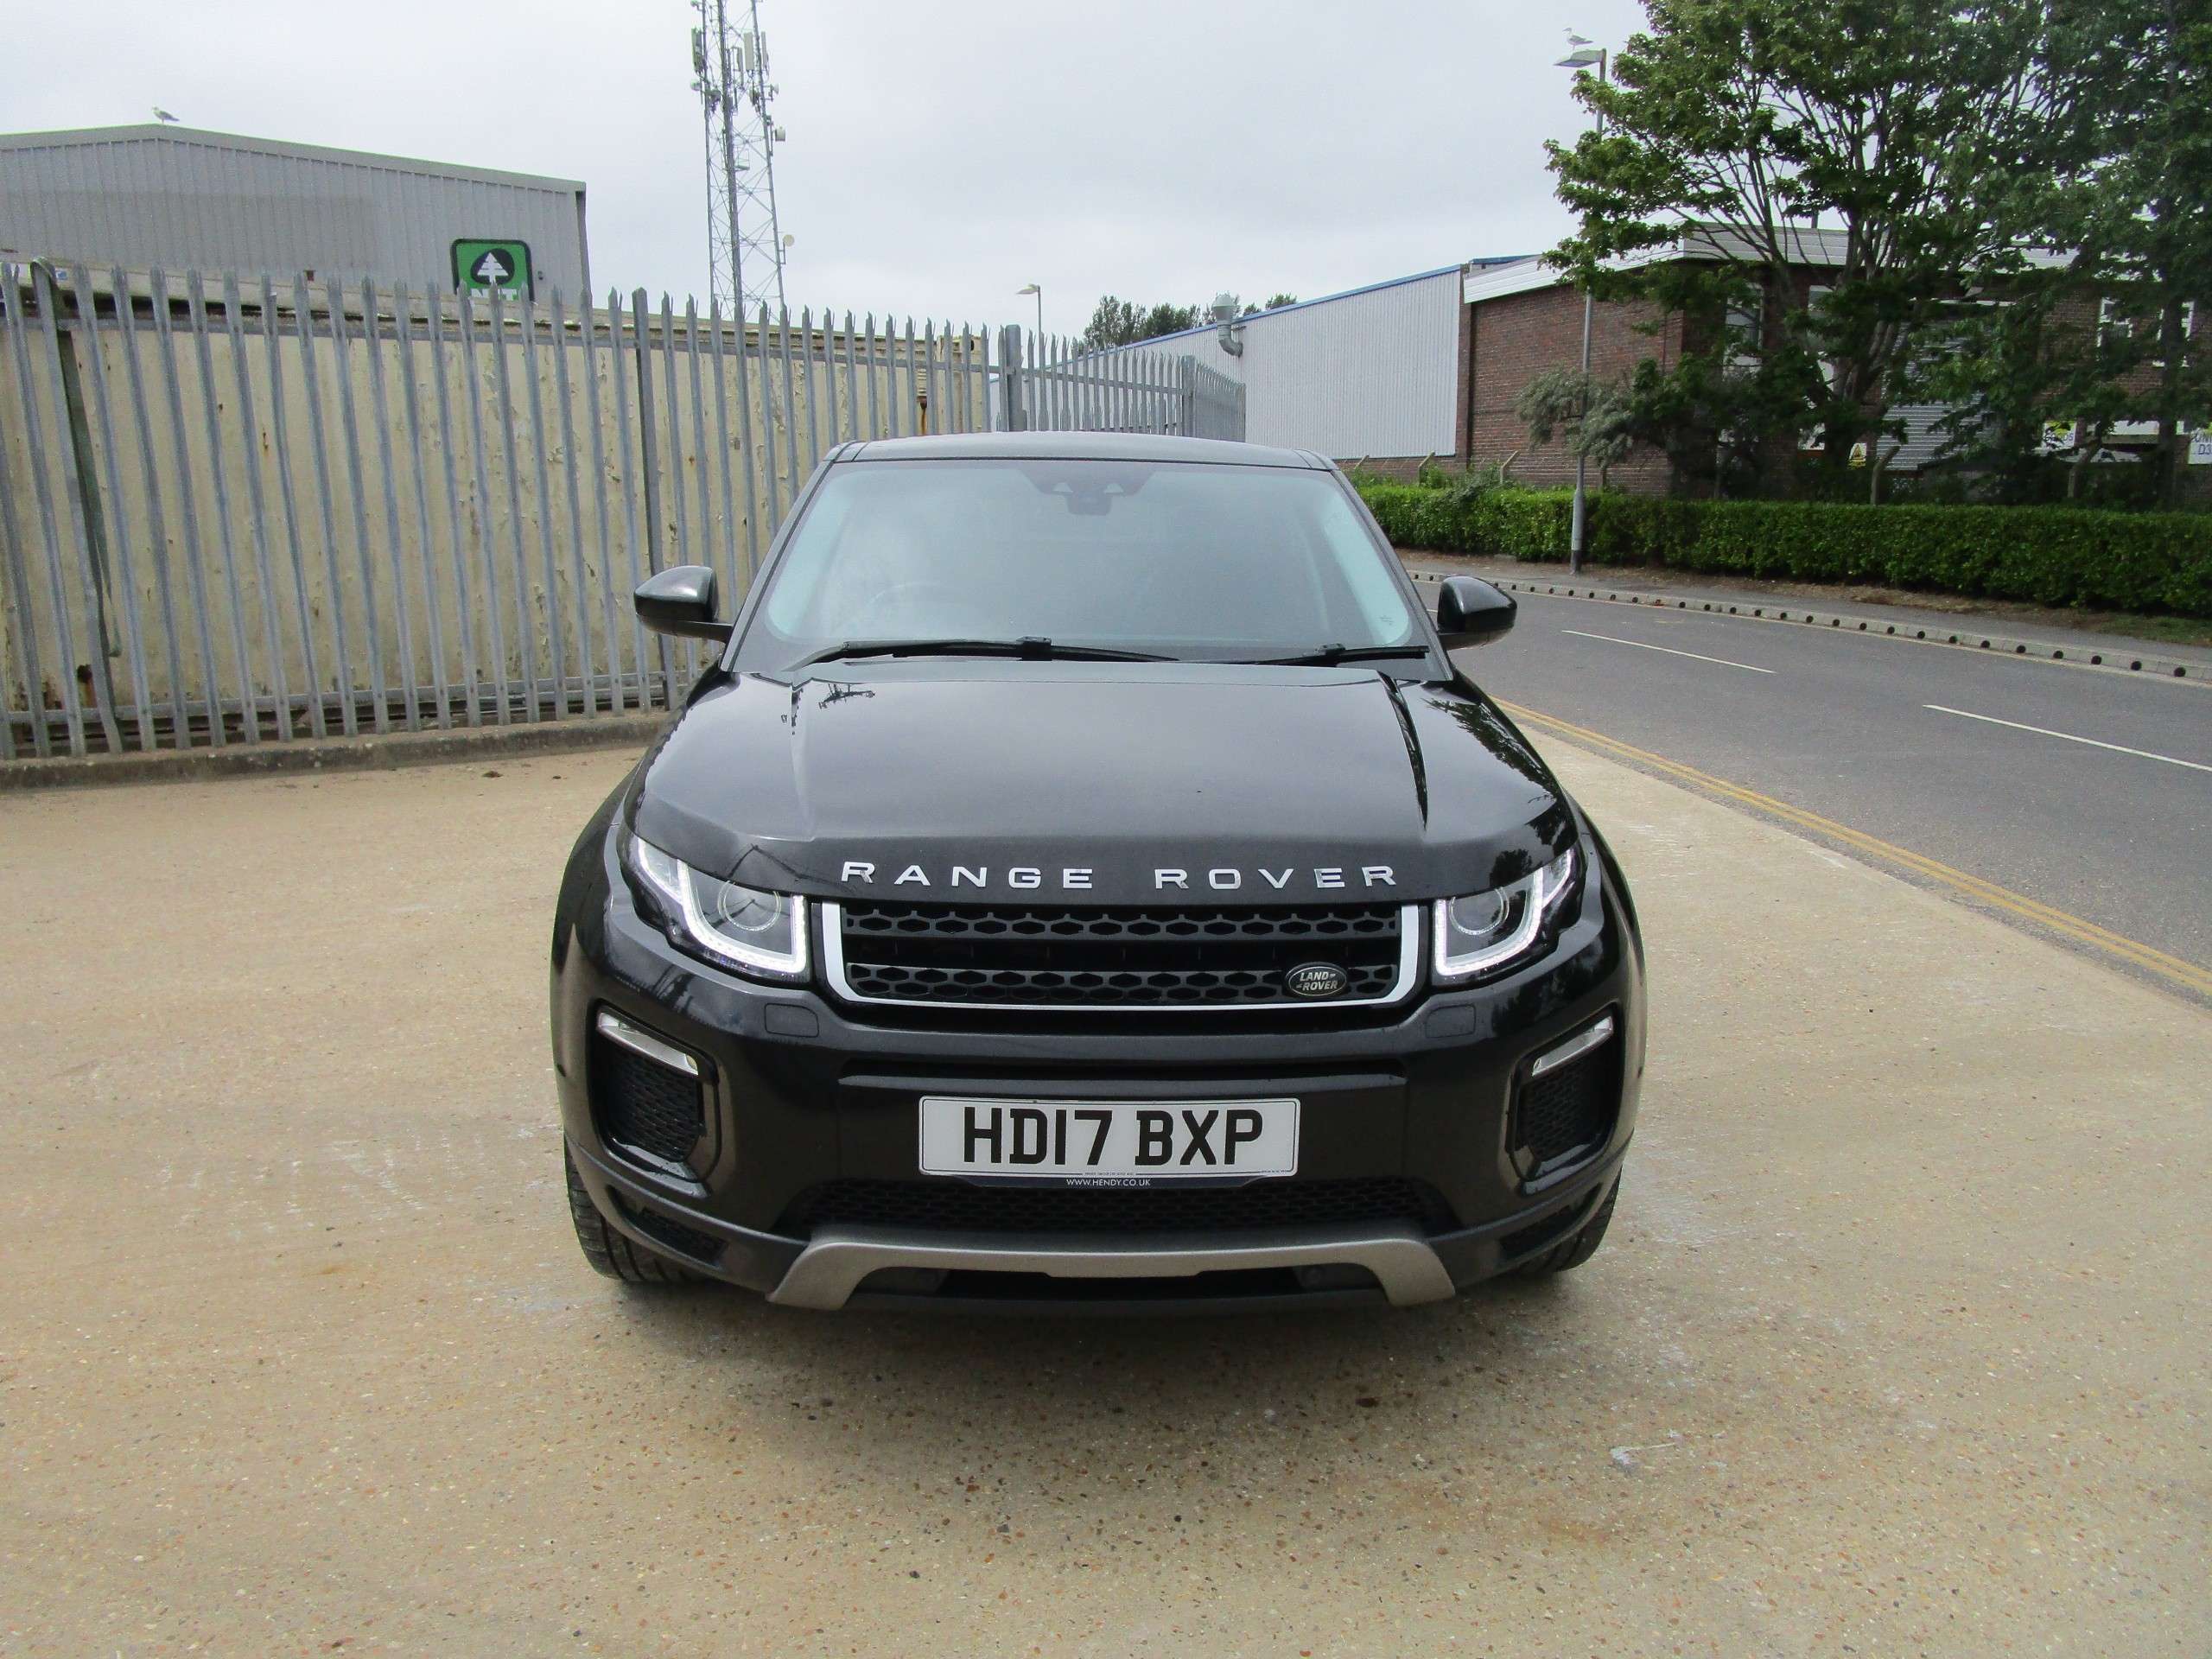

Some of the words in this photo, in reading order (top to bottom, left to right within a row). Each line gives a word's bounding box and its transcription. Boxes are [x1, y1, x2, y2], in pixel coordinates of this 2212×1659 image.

[841, 861, 1093, 889] RANGE
[1154, 865, 1397, 889] ROVER
[1300, 971, 1329, 982] LAND
[1302, 980, 1338, 991] ROVER
[963, 1106, 1113, 1166] HD17
[1135, 1109, 1264, 1166] BXP
[1066, 1179, 1151, 1187] WWW.HENDY.CO.UK
